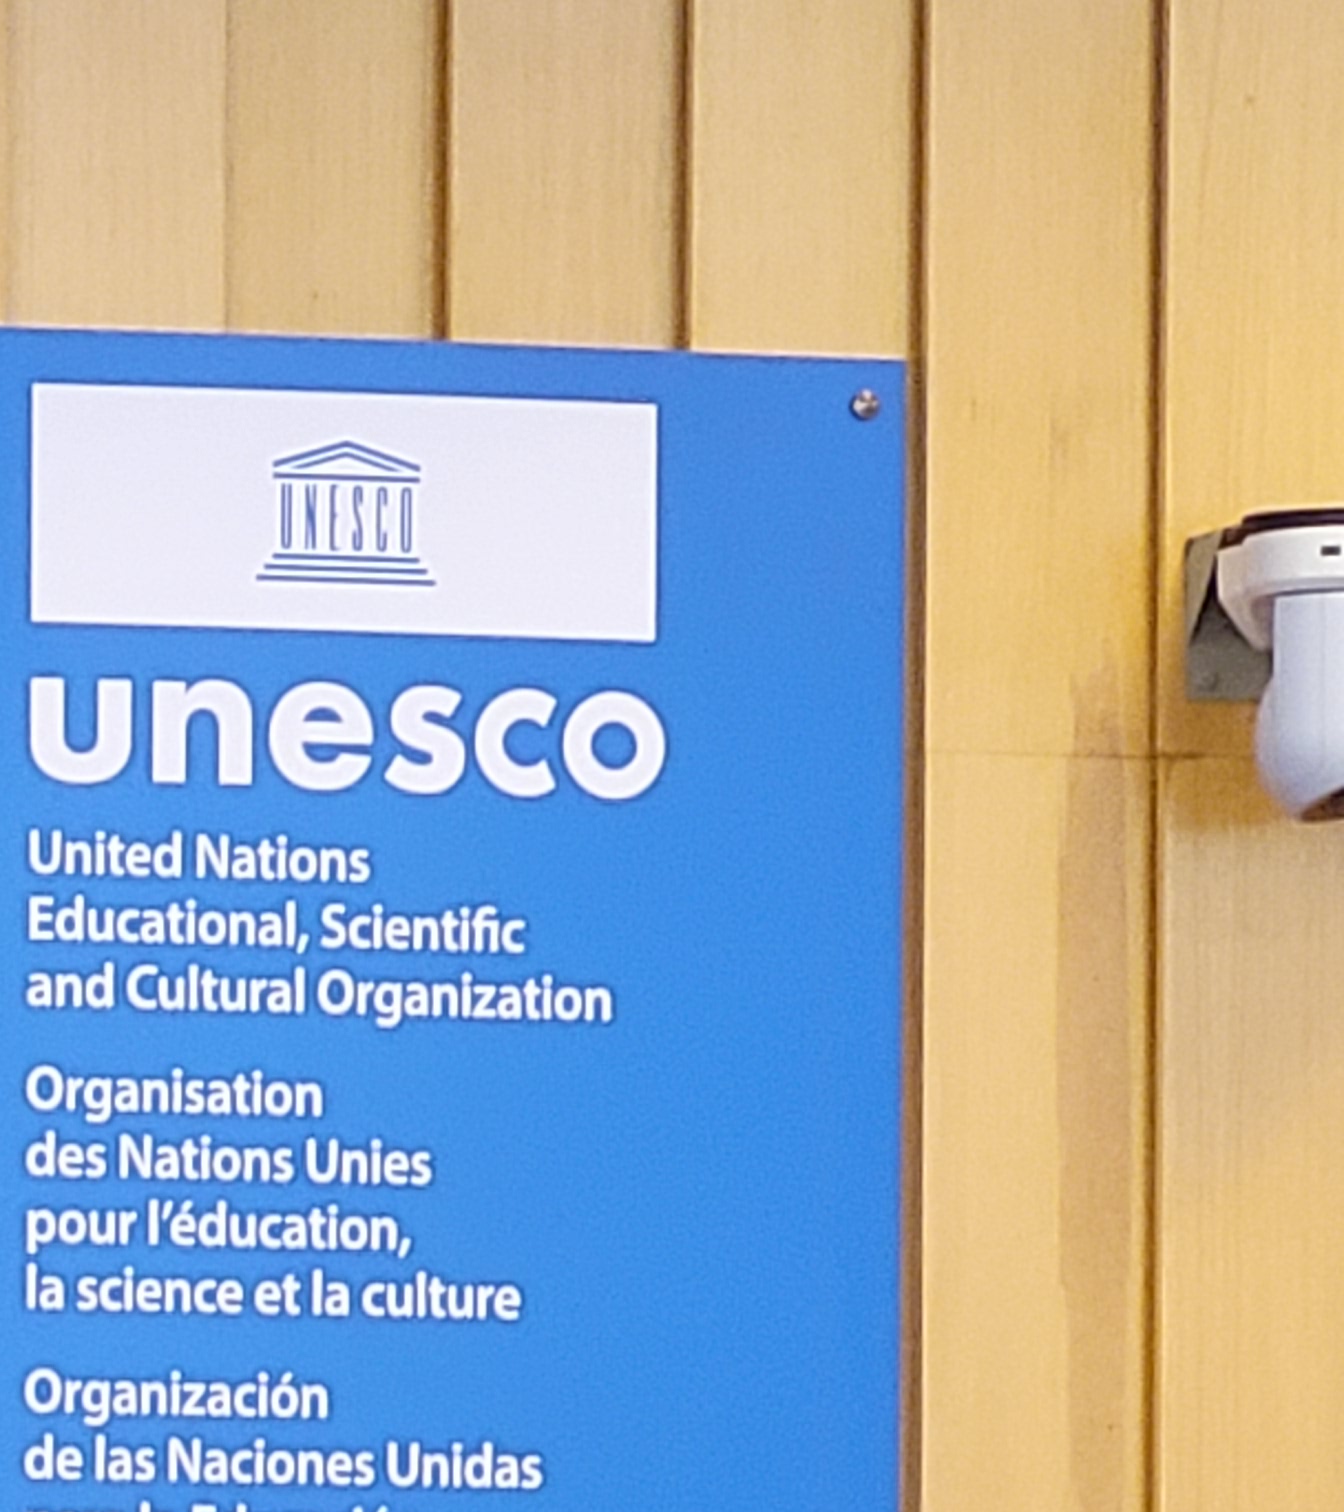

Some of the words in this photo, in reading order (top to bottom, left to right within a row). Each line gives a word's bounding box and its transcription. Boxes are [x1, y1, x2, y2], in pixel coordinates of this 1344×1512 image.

[280, 482, 413, 554] UNESCO
[30, 677, 665, 800] unesco
[29, 829, 182, 878] United
[196, 833, 370, 883] Nations
[28, 894, 309, 954] Educational,
[320, 903, 525, 954] Scientific
[26, 961, 114, 1009] and
[126, 964, 305, 1013] Cultural
[317, 969, 612, 1028] Organization
[26, 1065, 323, 1123] Organisation
[26, 1130, 107, 1178] des
[119, 1133, 294, 1183] Nations
[306, 1138, 432, 1186] Unies
[26, 1209, 138, 1255] pour
[148, 1199, 411, 1258] l’éducation,
[26, 1262, 65, 1310] la
[76, 1266, 244, 1314] science
[254, 1274, 301, 1316] et
[312, 1268, 350, 1316] la
[362, 1271, 521, 1320] culture
[24, 1368, 328, 1427] Organización
[24, 1433, 83, 1480] de
[95, 1434, 156, 1482] las
[168, 1437, 375, 1486] Naciones
[387, 1441, 542, 1489] Unidas
